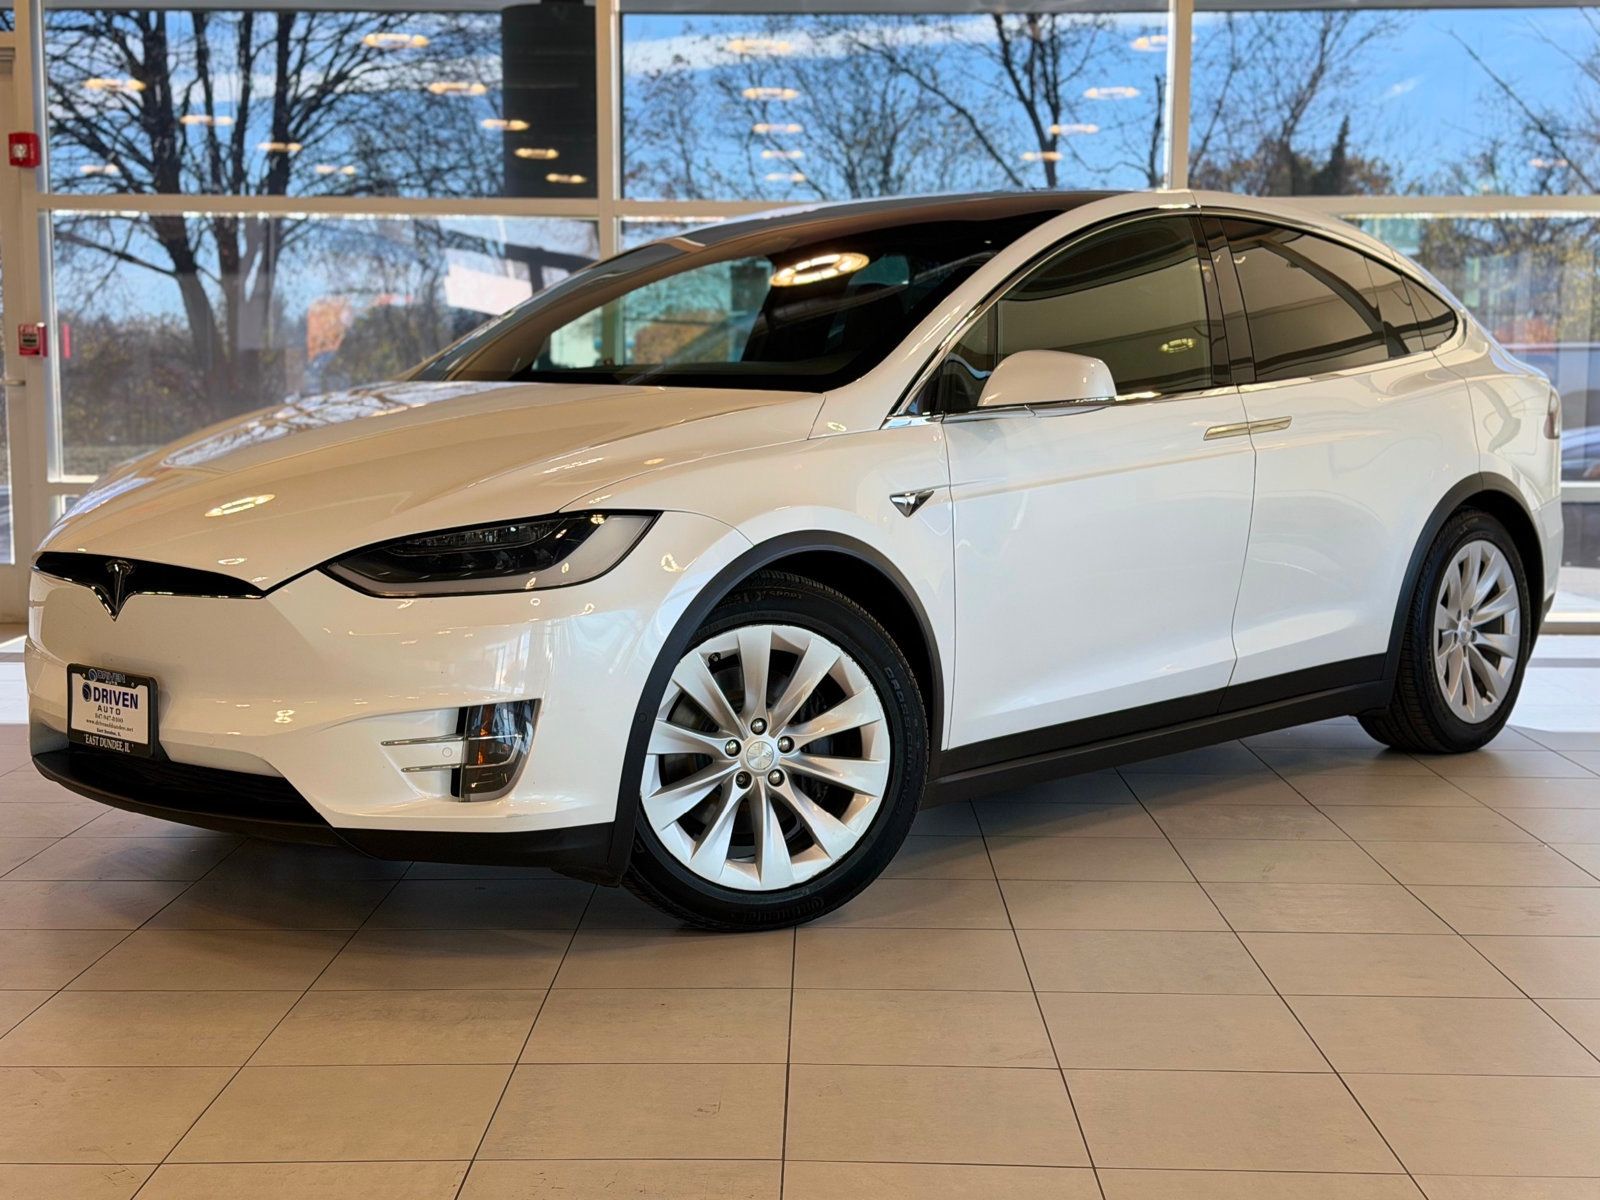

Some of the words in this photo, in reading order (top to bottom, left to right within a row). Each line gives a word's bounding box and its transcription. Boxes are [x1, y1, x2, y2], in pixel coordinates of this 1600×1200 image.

[93, 686, 138, 709] DRIVEN
[97, 704, 121, 716] AUTO
[85, 734, 99, 746] EAST
[124, 742, 131, 753] IL
